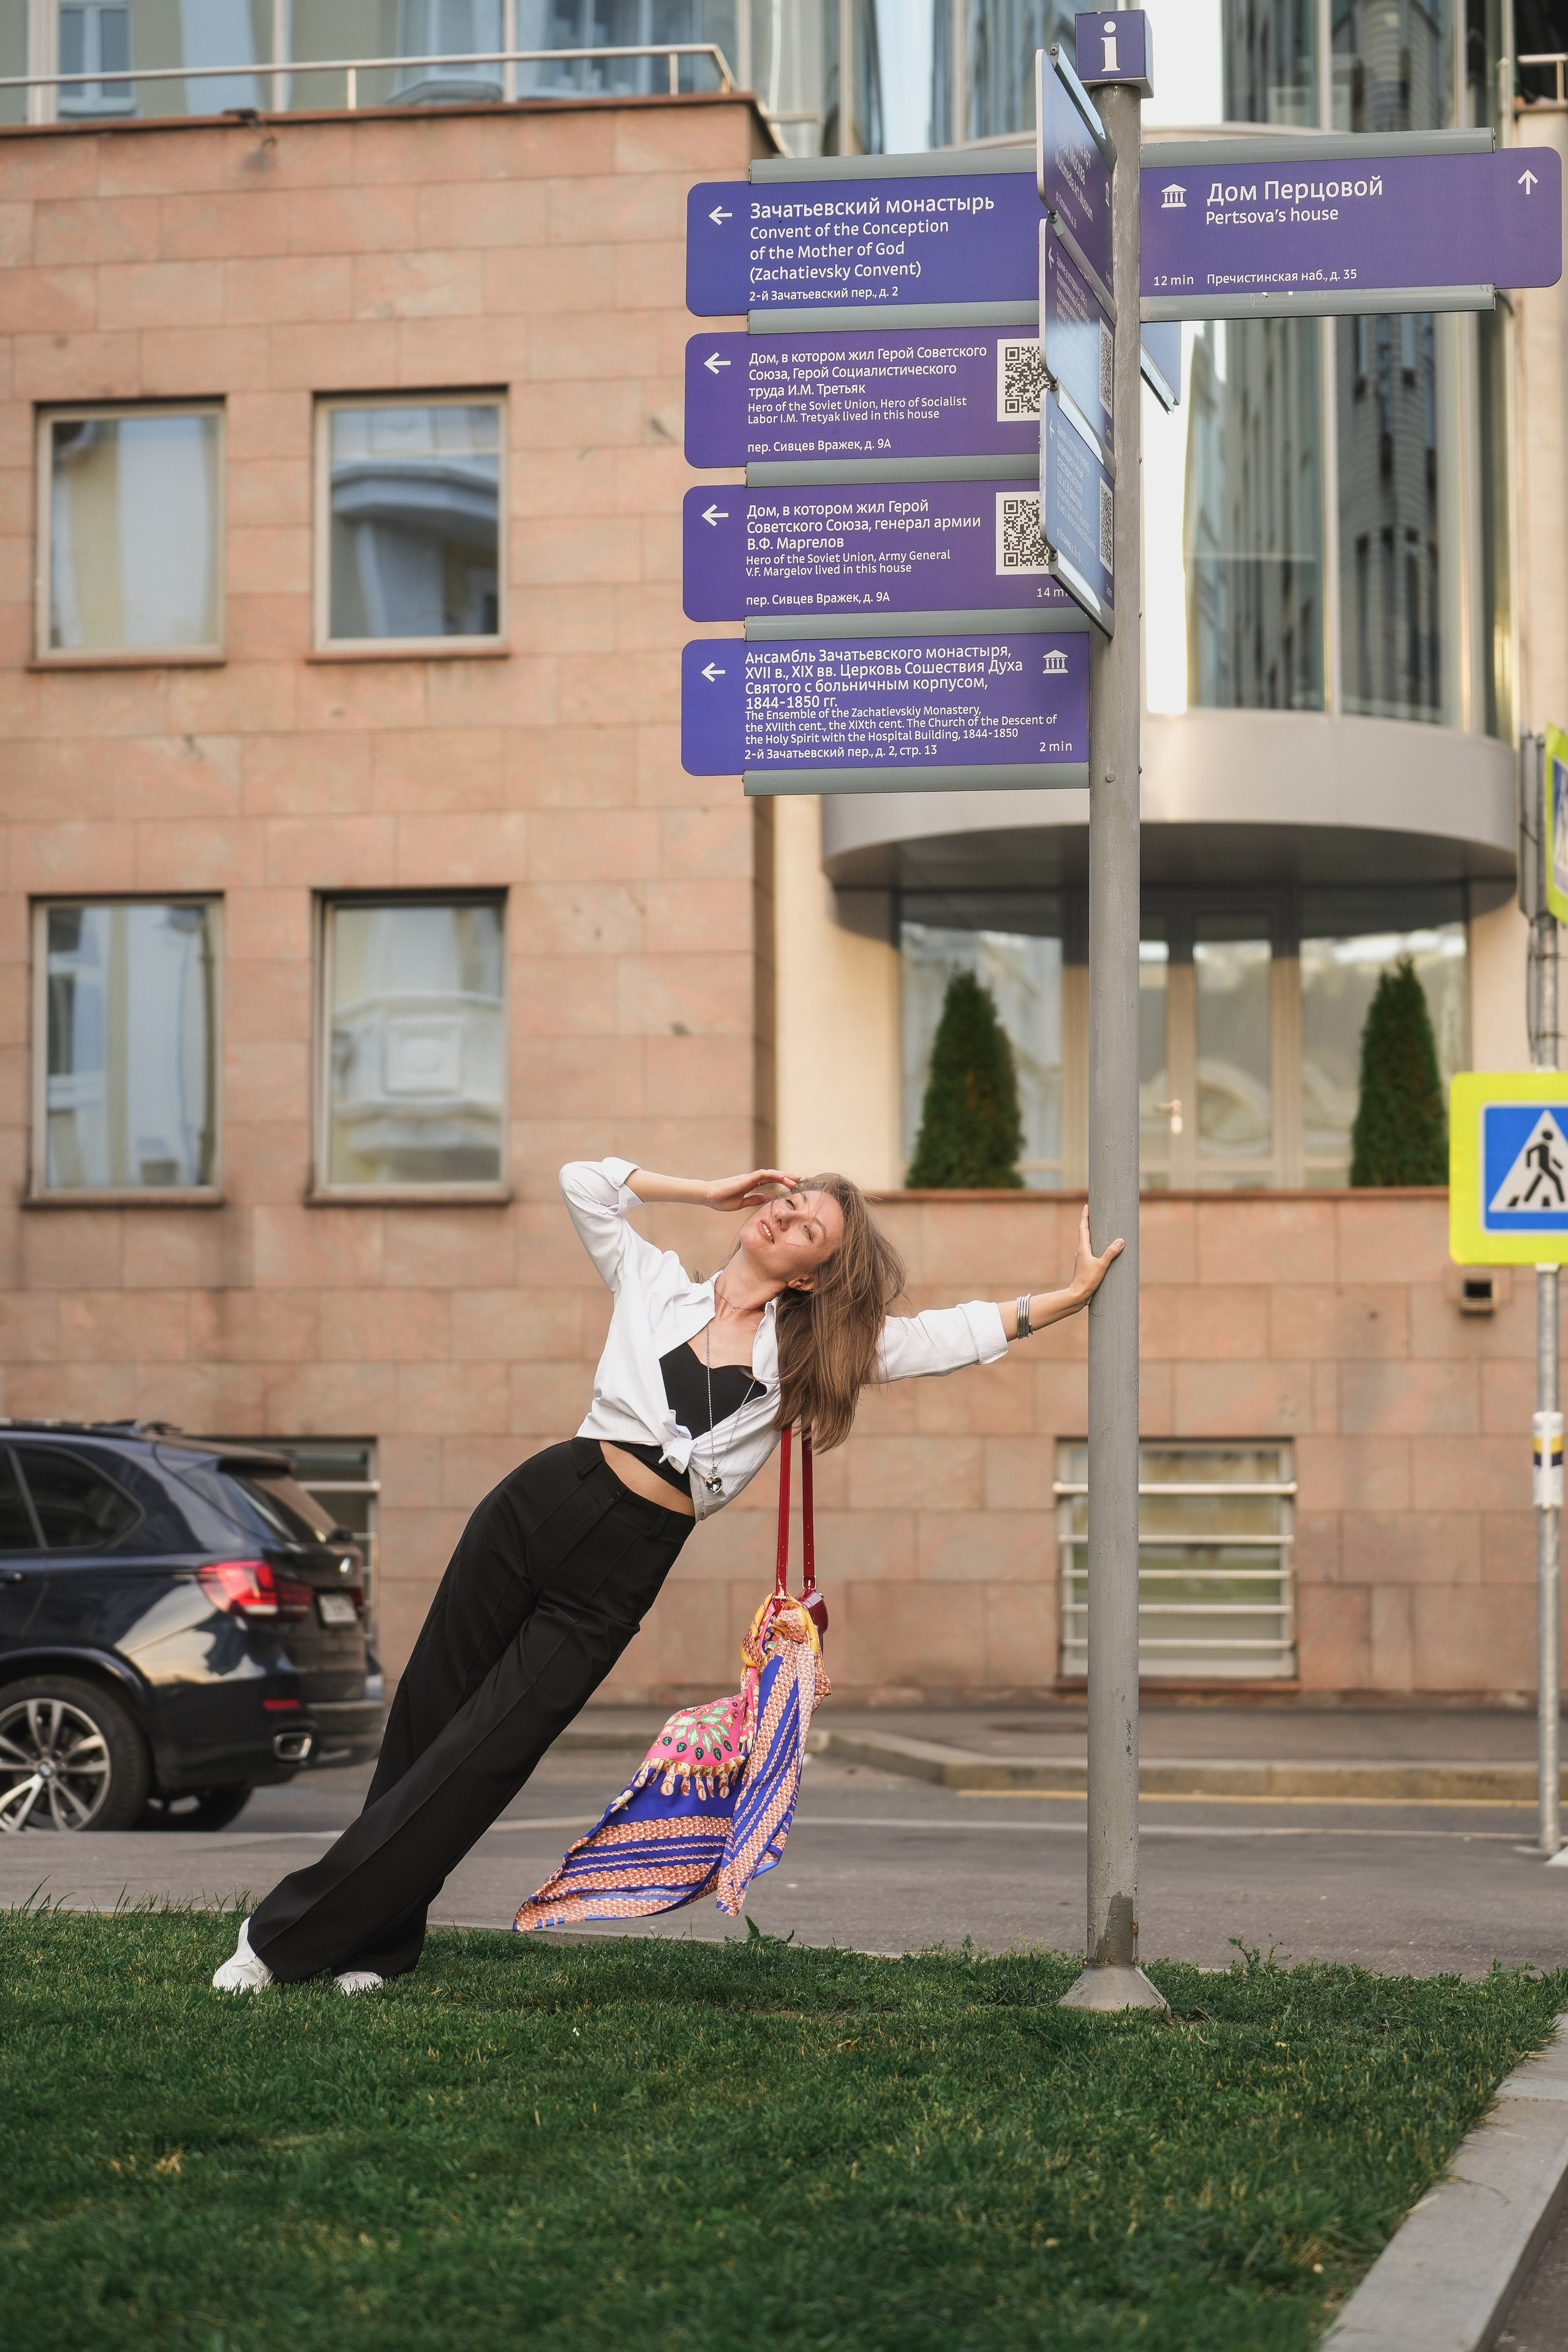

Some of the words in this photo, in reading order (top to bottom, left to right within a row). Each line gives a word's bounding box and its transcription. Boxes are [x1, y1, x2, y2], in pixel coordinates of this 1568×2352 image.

[1206, 183, 1257, 207] Дом
[1264, 175, 1383, 205] Перцовой
[750, 196, 880, 219] Зачатьевский
[886, 196, 995, 215] монастырь
[1206, 208, 1287, 225] Pertsova's
[1291, 206, 1339, 222] house
[750, 224, 812, 239] Convent
[815, 222, 831, 238] of
[832, 222, 859, 236] the
[862, 219, 949, 237] Conception
[750, 246, 766, 260] of
[767, 245, 794, 260] the
[797, 243, 854, 258] Mother
[856, 241, 873, 257] of
[875, 240, 905, 255] God
[749, 263, 851, 284] (Zachatievsky
[854, 260, 922, 279] Convent)
[1153, 275, 1168, 286] 12
[1170, 274, 1194, 285] min
[1207, 273, 1298, 287] Пречистинская
[1301, 269, 1329, 282] наб.,
[1329, 271, 1341, 282] д.
[1343, 268, 1357, 280] 35
[748, 290, 769, 302] 2-й
[771, 287, 848, 301] Зачатьевский
[851, 288, 878, 300] пер.,
[878, 288, 889, 299] д.
[891, 285, 899, 296] 2
[748, 352, 779, 367] Дом,
[781, 353, 789, 363] в
[791, 351, 846, 365] котором
[848, 350, 875, 361] жил
[878, 346, 914, 363] Герой
[916, 346, 987, 358] Советского
[748, 369, 791, 382] Союза,
[793, 366, 829, 382] Герой
[832, 364, 957, 380] Социалистического
[748, 386, 785, 401] труда
[788, 383, 815, 396] И.М.
[816, 383, 866, 398] Третьяк
[748, 402, 773, 413] Hero
[775, 401, 787, 412] of
[788, 401, 807, 412] the
[809, 399, 842, 411] Soviet
[844, 399, 878, 410] Union,
[880, 398, 906, 409] Hero
[908, 396, 921, 408] of
[921, 396, 968, 407] Socialist
[748, 413, 778, 424] Labor
[780, 413, 799, 423] I.M.
[800, 411, 841, 424] Tretyak
[842, 410, 868, 421] lived
[870, 410, 881, 421] in
[883, 409, 905, 420] this
[907, 409, 940, 420] house
[747, 443, 771, 455] пер.
[773, 441, 815, 453] Сивцев
[818, 440, 863, 453] Вражек,
[864, 440, 875, 451] д.
[877, 438, 892, 449] 9А
[746, 504, 780, 520] Дом,
[782, 505, 791, 516] в
[793, 503, 853, 518] котором
[856, 503, 885, 514] жил
[888, 499, 929, 516] Герой
[747, 521, 823, 534] Советского
[826, 518, 872, 533] Союза,
[875, 518, 930, 533] генерал
[933, 516, 981, 532] армии
[747, 537, 774, 551] В.Ф.
[776, 537, 845, 552] Маргелов
[746, 555, 772, 565] Hero
[773, 553, 786, 565] of
[786, 553, 805, 564] the
[807, 552, 841, 564] Soviet
[842, 551, 877, 564] Union,
[878, 551, 907, 564] Army
[908, 549, 951, 560] General
[745, 567, 761, 577] V.F.
[763, 565, 813, 579] Margelov
[815, 564, 840, 575] lived
[843, 564, 853, 575] in
[855, 563, 877, 574] this
[879, 562, 912, 573] house
[746, 596, 770, 608] пер.
[772, 594, 814, 606] Сивцев
[816, 593, 862, 606] Вражек,
[862, 594, 873, 605] д.
[875, 591, 891, 602] 9А
[1037, 587, 1050, 598] 14
[744, 649, 816, 665] Ансамбль
[818, 648, 922, 662] Зачатьевского
[925, 646, 1012, 660] монастыря,
[744, 666, 771, 680] XVII
[775, 668, 790, 681] в.,
[791, 665, 814, 678] XIX
[816, 666, 837, 677] вв.
[840, 663, 902, 679] Церковь
[904, 662, 985, 675] Сошествия
[987, 659, 1023, 676] Духа
[745, 682, 802, 695] Святого
[804, 682, 812, 693] с
[815, 678, 909, 693] больничным
[913, 677, 988, 693] корпусом,
[746, 695, 820, 710] 1844-1850
[823, 696, 838, 707] гг.
[744, 710, 764, 721] The
[766, 708, 816, 720] Ensemble
[818, 707, 831, 718] of
[831, 707, 850, 718] the
[851, 705, 922, 718] Zachatievskiy
[923, 705, 982, 717] Monastery,
[745, 722, 764, 733] the
[764, 720, 796, 733] XVIIth
[798, 721, 827, 733] cent.,
[827, 720, 846, 731] the
[848, 718, 876, 730] XIXth
[878, 718, 905, 729] cent.
[906, 717, 926, 728] The
[928, 716, 965, 728] Church
[967, 715, 979, 727] of
[980, 715, 999, 726] the
[1001, 715, 1044, 726] Descent
[1046, 714, 1058, 725] of
[744, 734, 764, 745] the
[765, 733, 790, 747] Holy
[790, 733, 820, 746] Spirit
[821, 731, 845, 743] with
[847, 731, 866, 742] the
[868, 729, 913, 744] Hospital
[914, 729, 961, 742] Building,
[963, 728, 1019, 739] 1844-1850
[1039, 741, 1046, 752] 2
[1049, 740, 1072, 752] min
[744, 748, 764, 760] 2-й
[766, 746, 845, 760] Зачатьевский
[847, 748, 874, 760] пер.,
[875, 747, 886, 758] д.
[888, 745, 898, 758] 2,
[899, 747, 922, 758] стр.
[924, 744, 937, 755] 13
